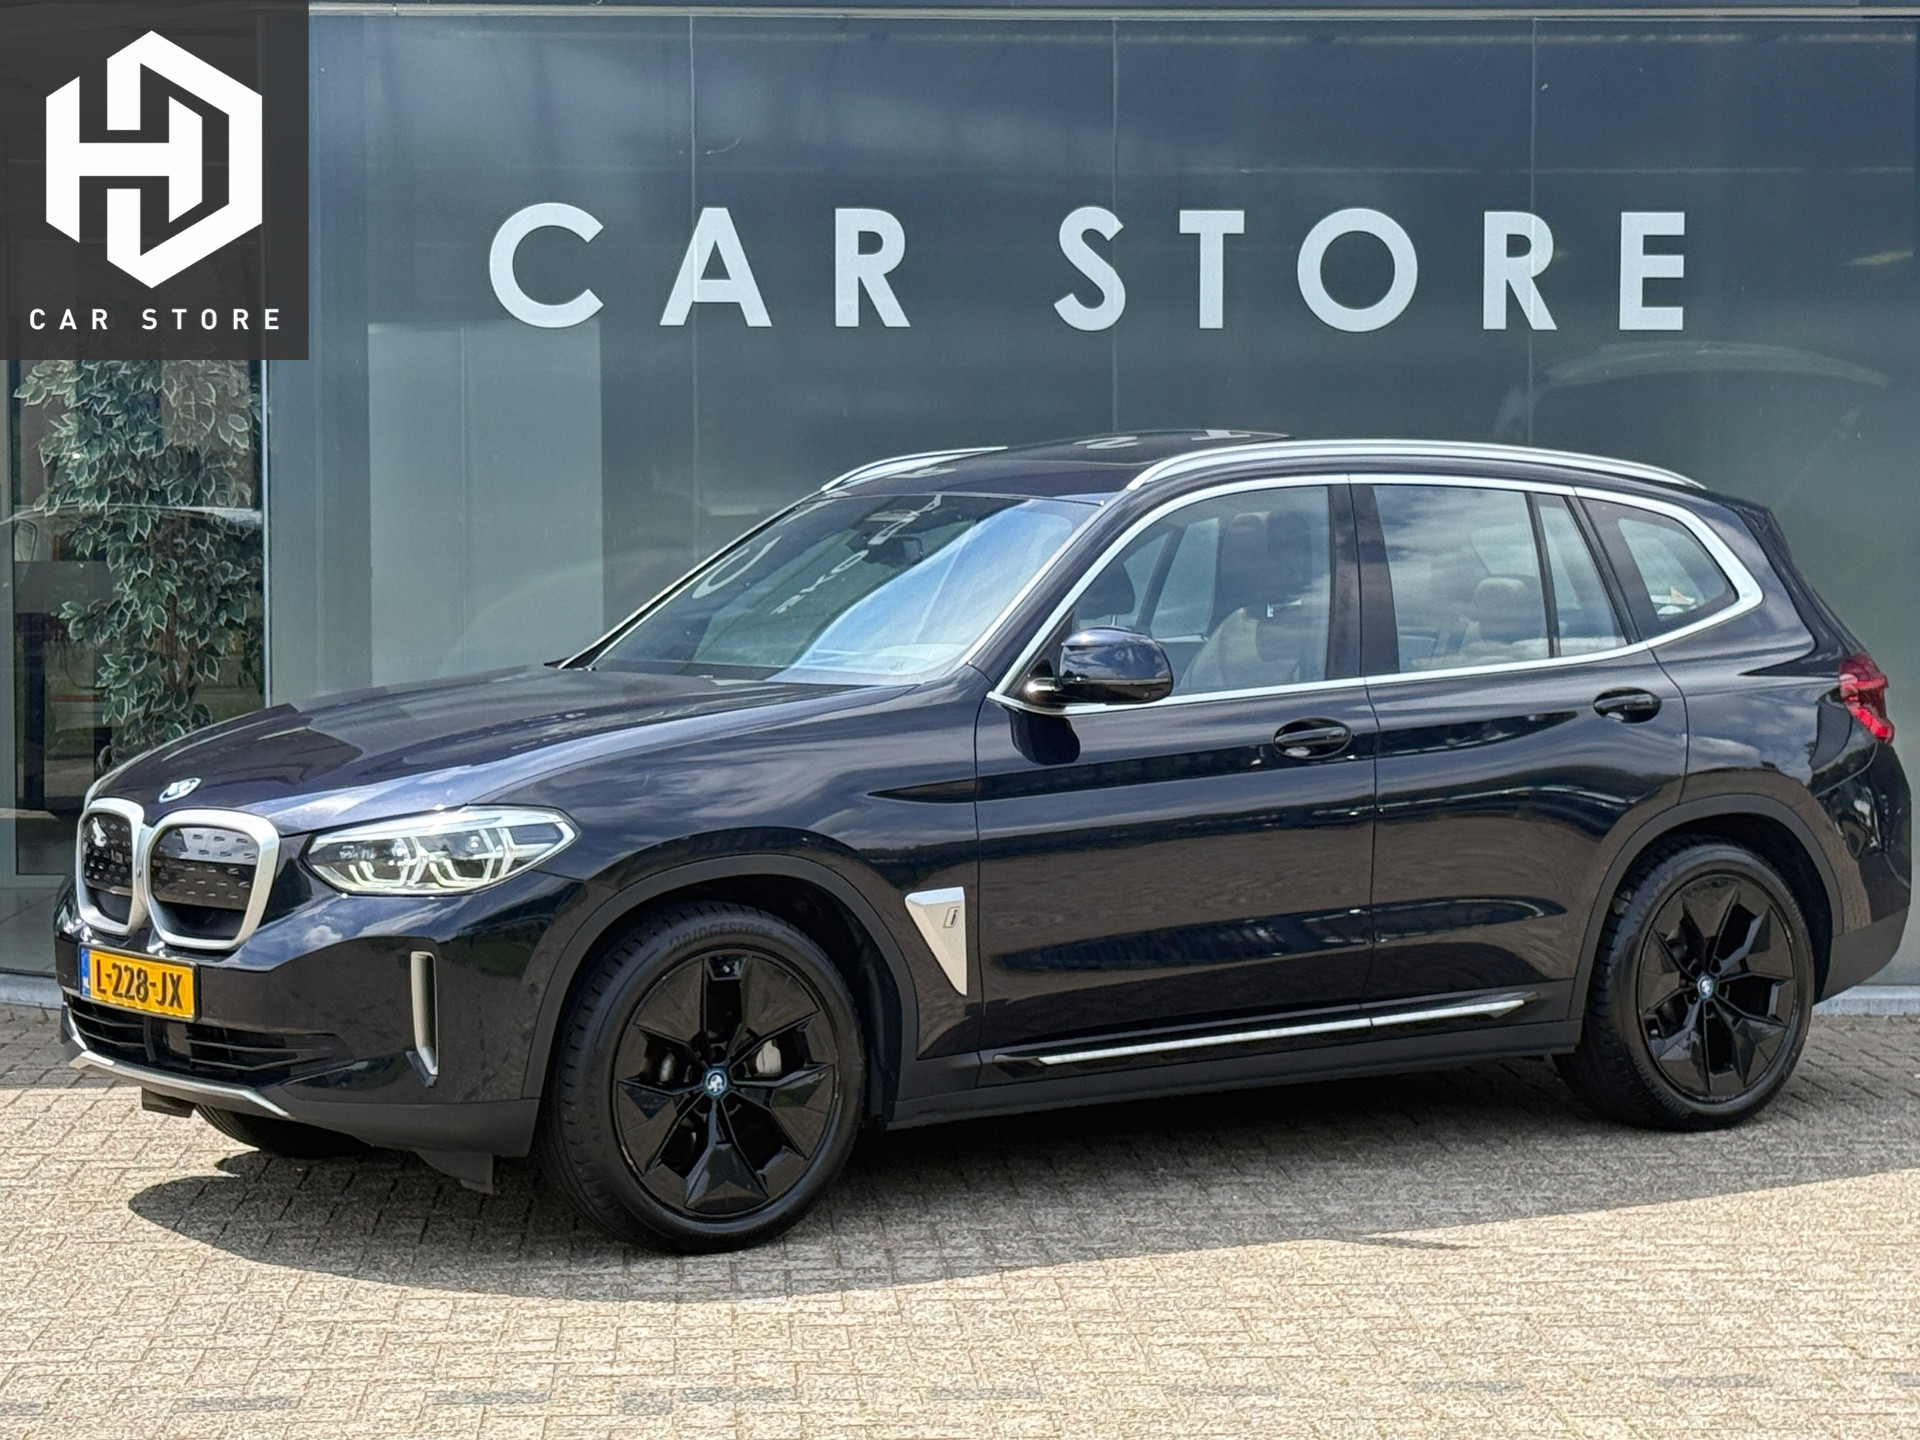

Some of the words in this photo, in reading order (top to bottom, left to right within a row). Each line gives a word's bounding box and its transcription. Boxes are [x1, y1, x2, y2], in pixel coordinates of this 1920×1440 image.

[489, 202, 911, 330] CAR
[1054, 206, 1687, 333] STORE
[669, 921, 775, 949] BRIDGESTONE
[97, 960, 183, 1009] L-228-JX
